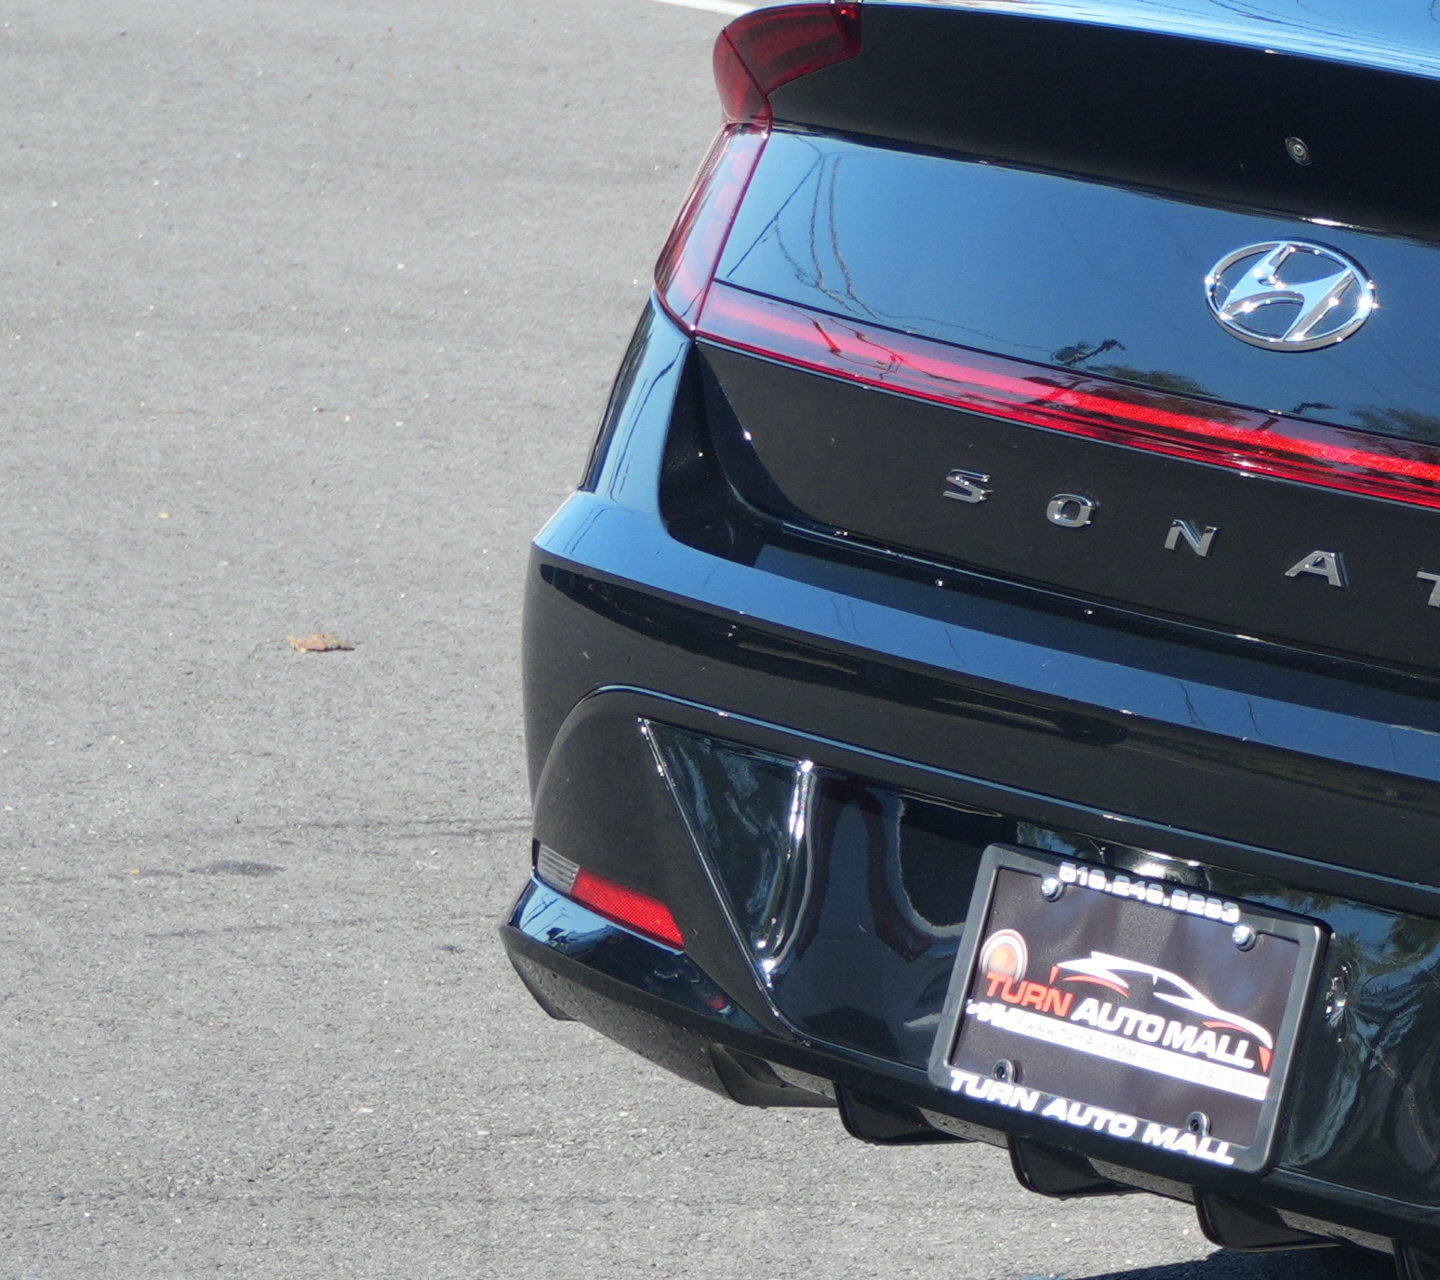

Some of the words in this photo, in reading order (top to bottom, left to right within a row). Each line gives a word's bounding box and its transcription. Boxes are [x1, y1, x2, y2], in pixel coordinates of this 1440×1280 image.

[984, 970, 1075, 1017] TURN
[948, 1070, 1042, 1114] TURN
[1040, 1096, 1138, 1139] AUTO
[1141, 1124, 1236, 1167] MALL
